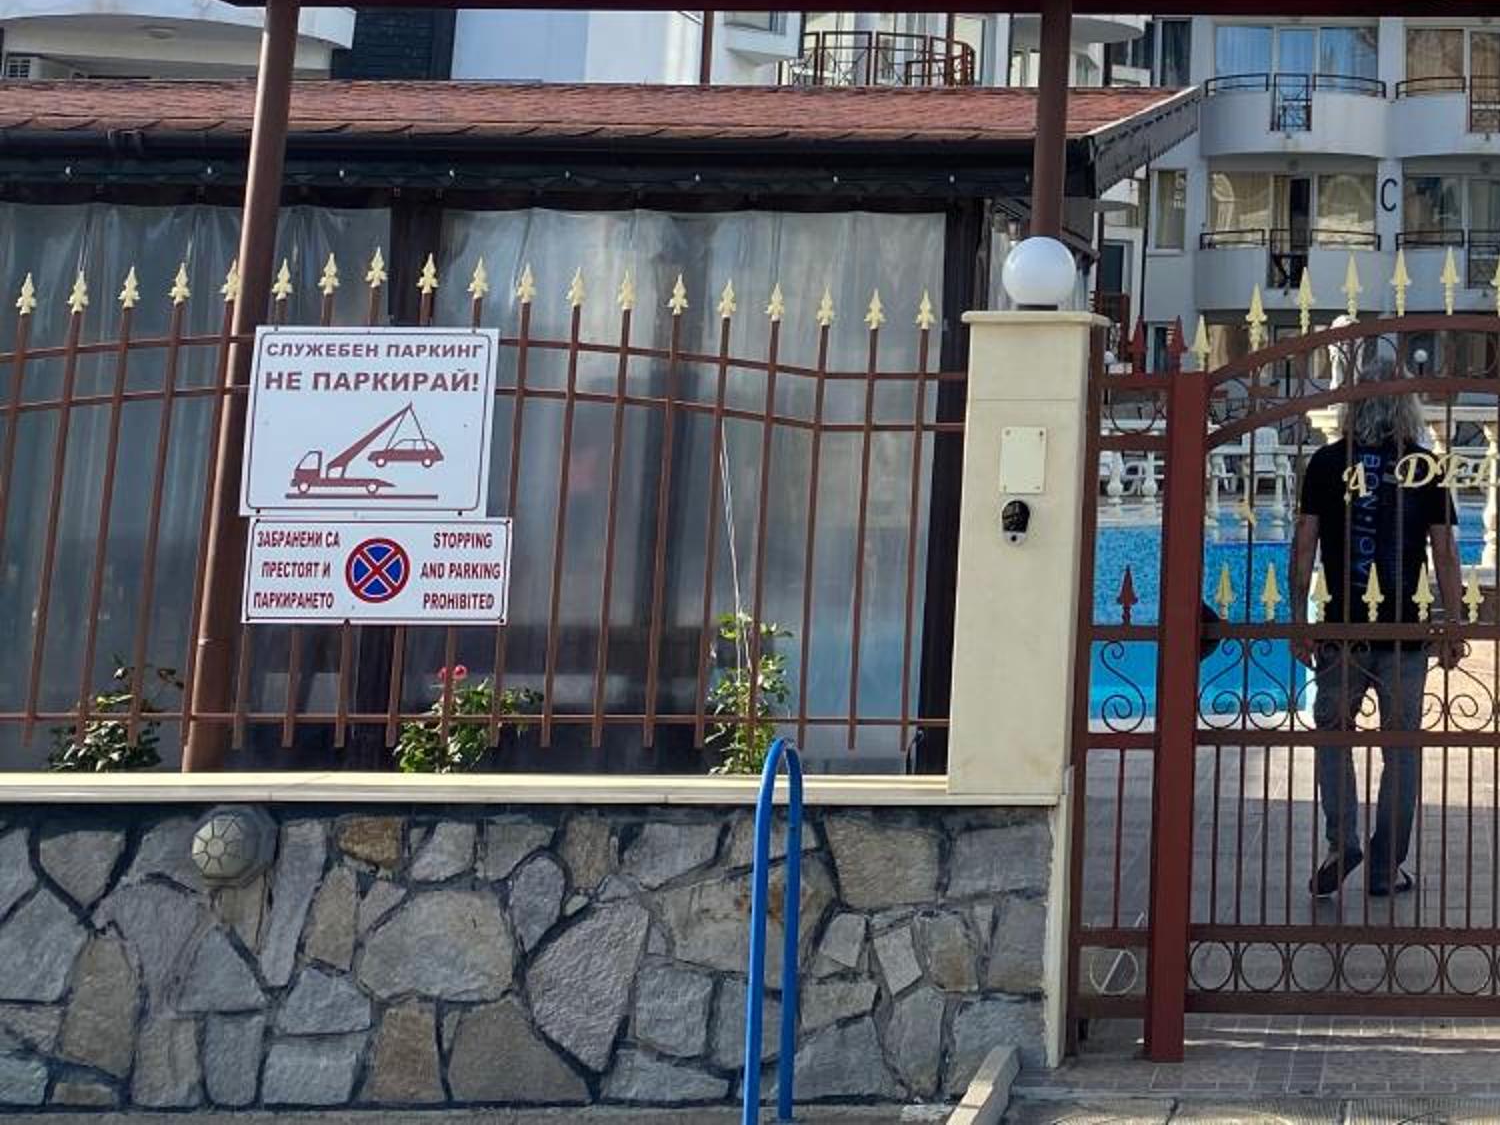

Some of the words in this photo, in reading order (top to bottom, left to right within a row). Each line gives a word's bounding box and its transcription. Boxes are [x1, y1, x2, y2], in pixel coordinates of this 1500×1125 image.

[1380, 178, 1398, 212] C
[266, 342, 379, 357] СЛУЖЕБЕН
[386, 344, 484, 358] ПАРКИНГ
[264, 371, 303, 391] НЕ
[313, 368, 479, 392] ПАРКИРАЙ!
[256, 531, 323, 548] ЗАБРАНЕНИ
[325, 532, 341, 548] СА
[432, 532, 493, 548] STOPPING
[261, 562, 320, 578] ПРЕСТОЯТ
[321, 562, 331, 578] И
[419, 562, 445, 578] AND
[447, 562, 502, 579] PARKING
[253, 592, 334, 609] ПАРКИРАНЕТО
[422, 592, 495, 610] PROHIBITED
